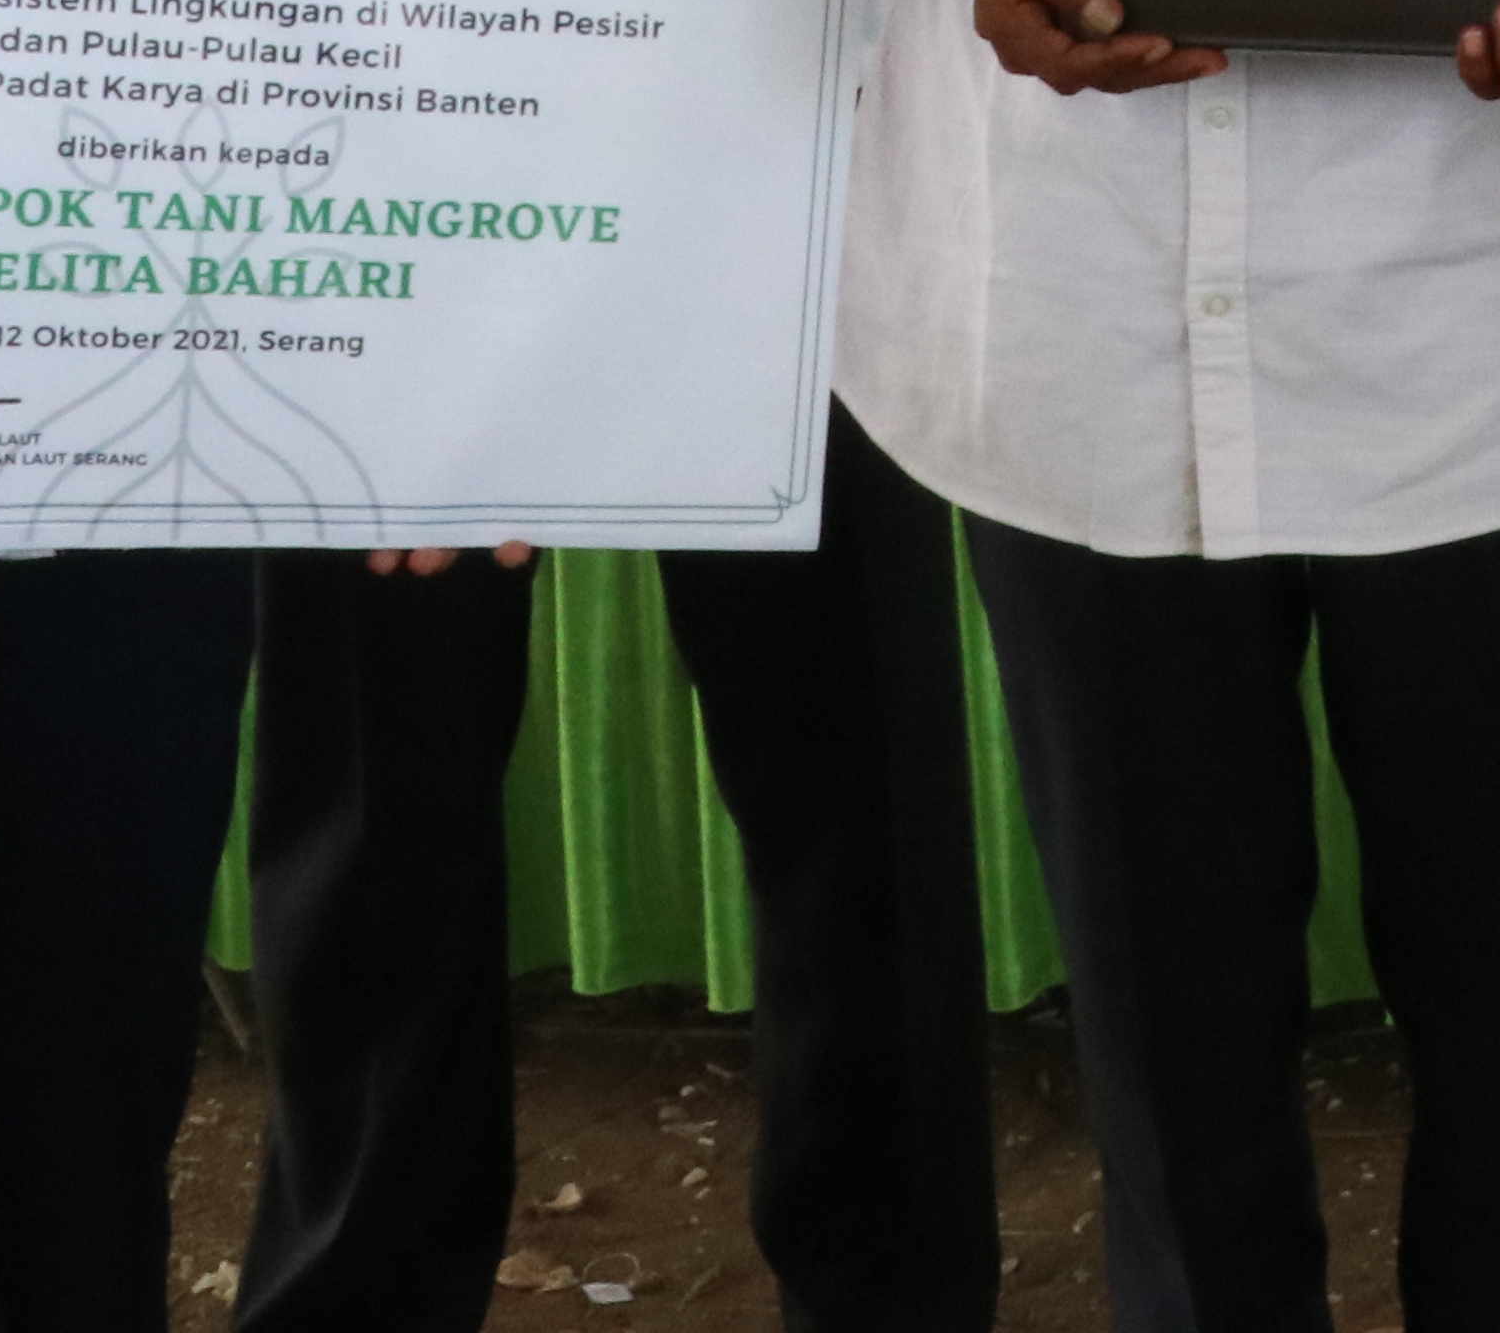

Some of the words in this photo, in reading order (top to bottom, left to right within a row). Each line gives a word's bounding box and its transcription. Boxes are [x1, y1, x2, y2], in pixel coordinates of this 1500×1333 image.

[355, 1, 387, 26] di
[401, 2, 540, 36] Wilayah
[552, 9, 664, 38] Pesisir
[82, 30, 302, 64] Pulau-Pulau
[315, 41, 401, 68] Kecil
[102, 74, 203, 108] Karya
[216, 79, 248, 105] di
[262, 81, 403, 111] Provinsi
[416, 87, 539, 116] Banten
[56, 135, 207, 162] diberikan
[218, 140, 329, 169] kepada
[116, 190, 263, 233] TANI
[286, 194, 620, 243] MANGROVE
[184, 256, 414, 299] BAHARI
[32, 325, 163, 350] Oktober
[172, 328, 246, 351] 2021,
[258, 329, 364, 357] Serang
[22, 451, 67, 465] LAUT
[72, 450, 147, 467] SERANG
